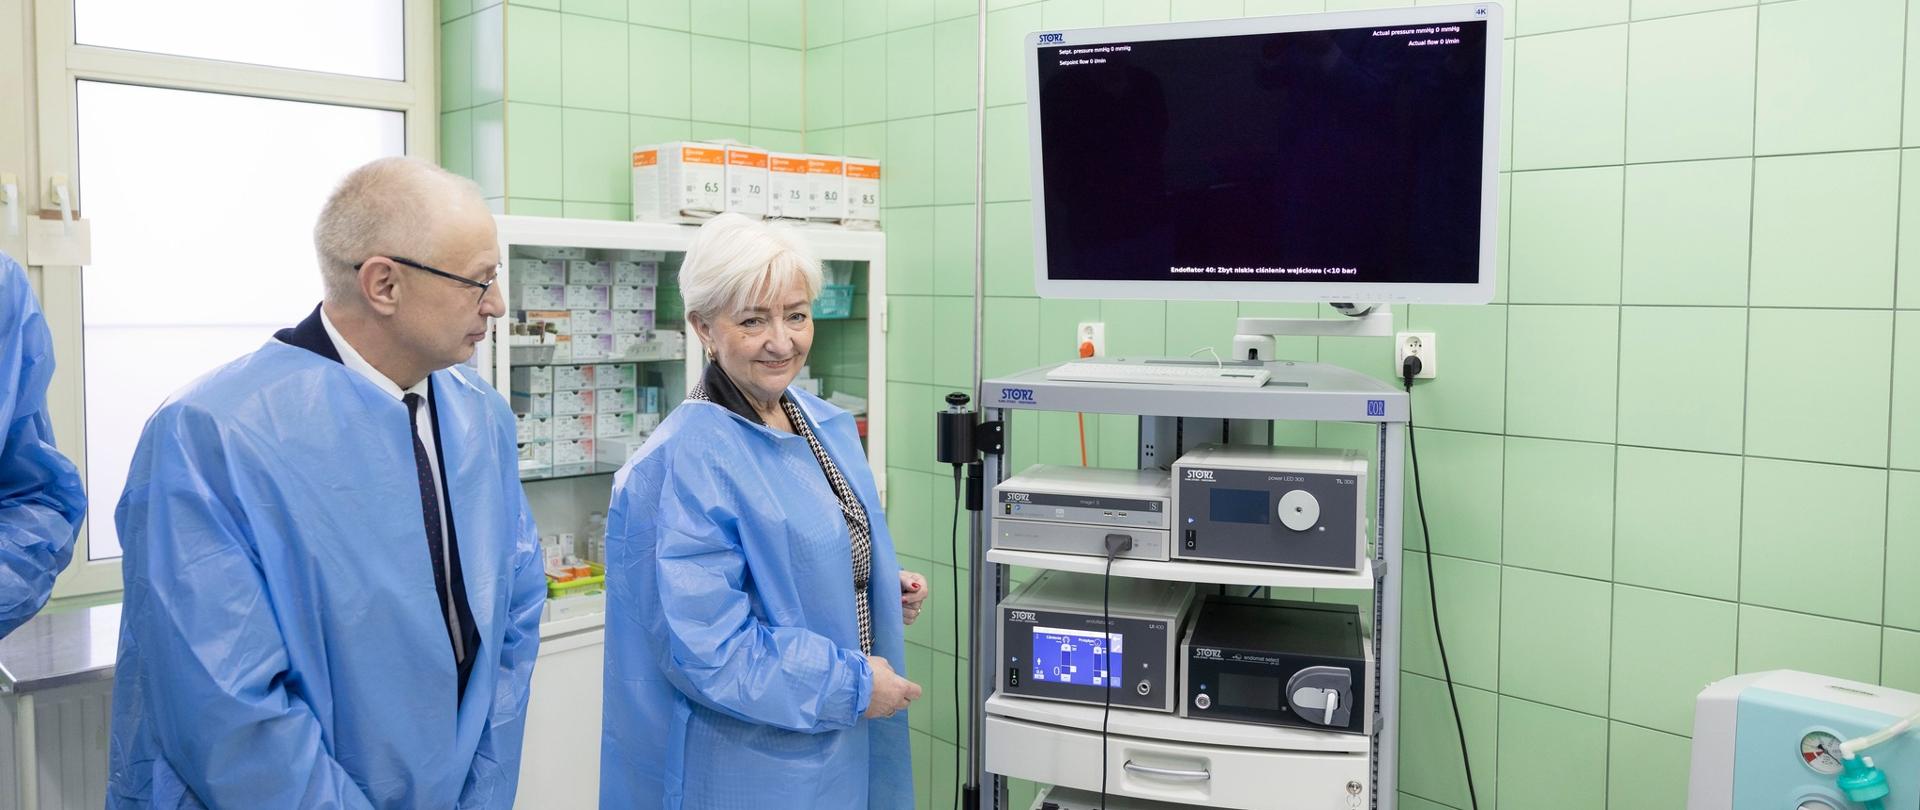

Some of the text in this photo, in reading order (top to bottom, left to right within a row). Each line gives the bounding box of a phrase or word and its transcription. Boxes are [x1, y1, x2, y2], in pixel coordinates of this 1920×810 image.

[1039, 33, 1063, 42] STORZ
[704, 182, 719, 193] 6.5
[749, 184, 761, 194] 7.0
[824, 191, 838, 201] 8.0
[862, 194, 875, 205] 8.5
[1217, 266, 1233, 275] Zbyt
[1286, 267, 1322, 275] wejściowe
[1323, 267, 1341, 275] (<10
[1002, 388, 1033, 401] STORZ
[1368, 401, 1384, 415] COR
[1187, 470, 1214, 479] STORZ
[1007, 492, 1030, 501] STORZ
[1011, 611, 1036, 621] STORZ
[1196, 648, 1222, 657] STORZ
